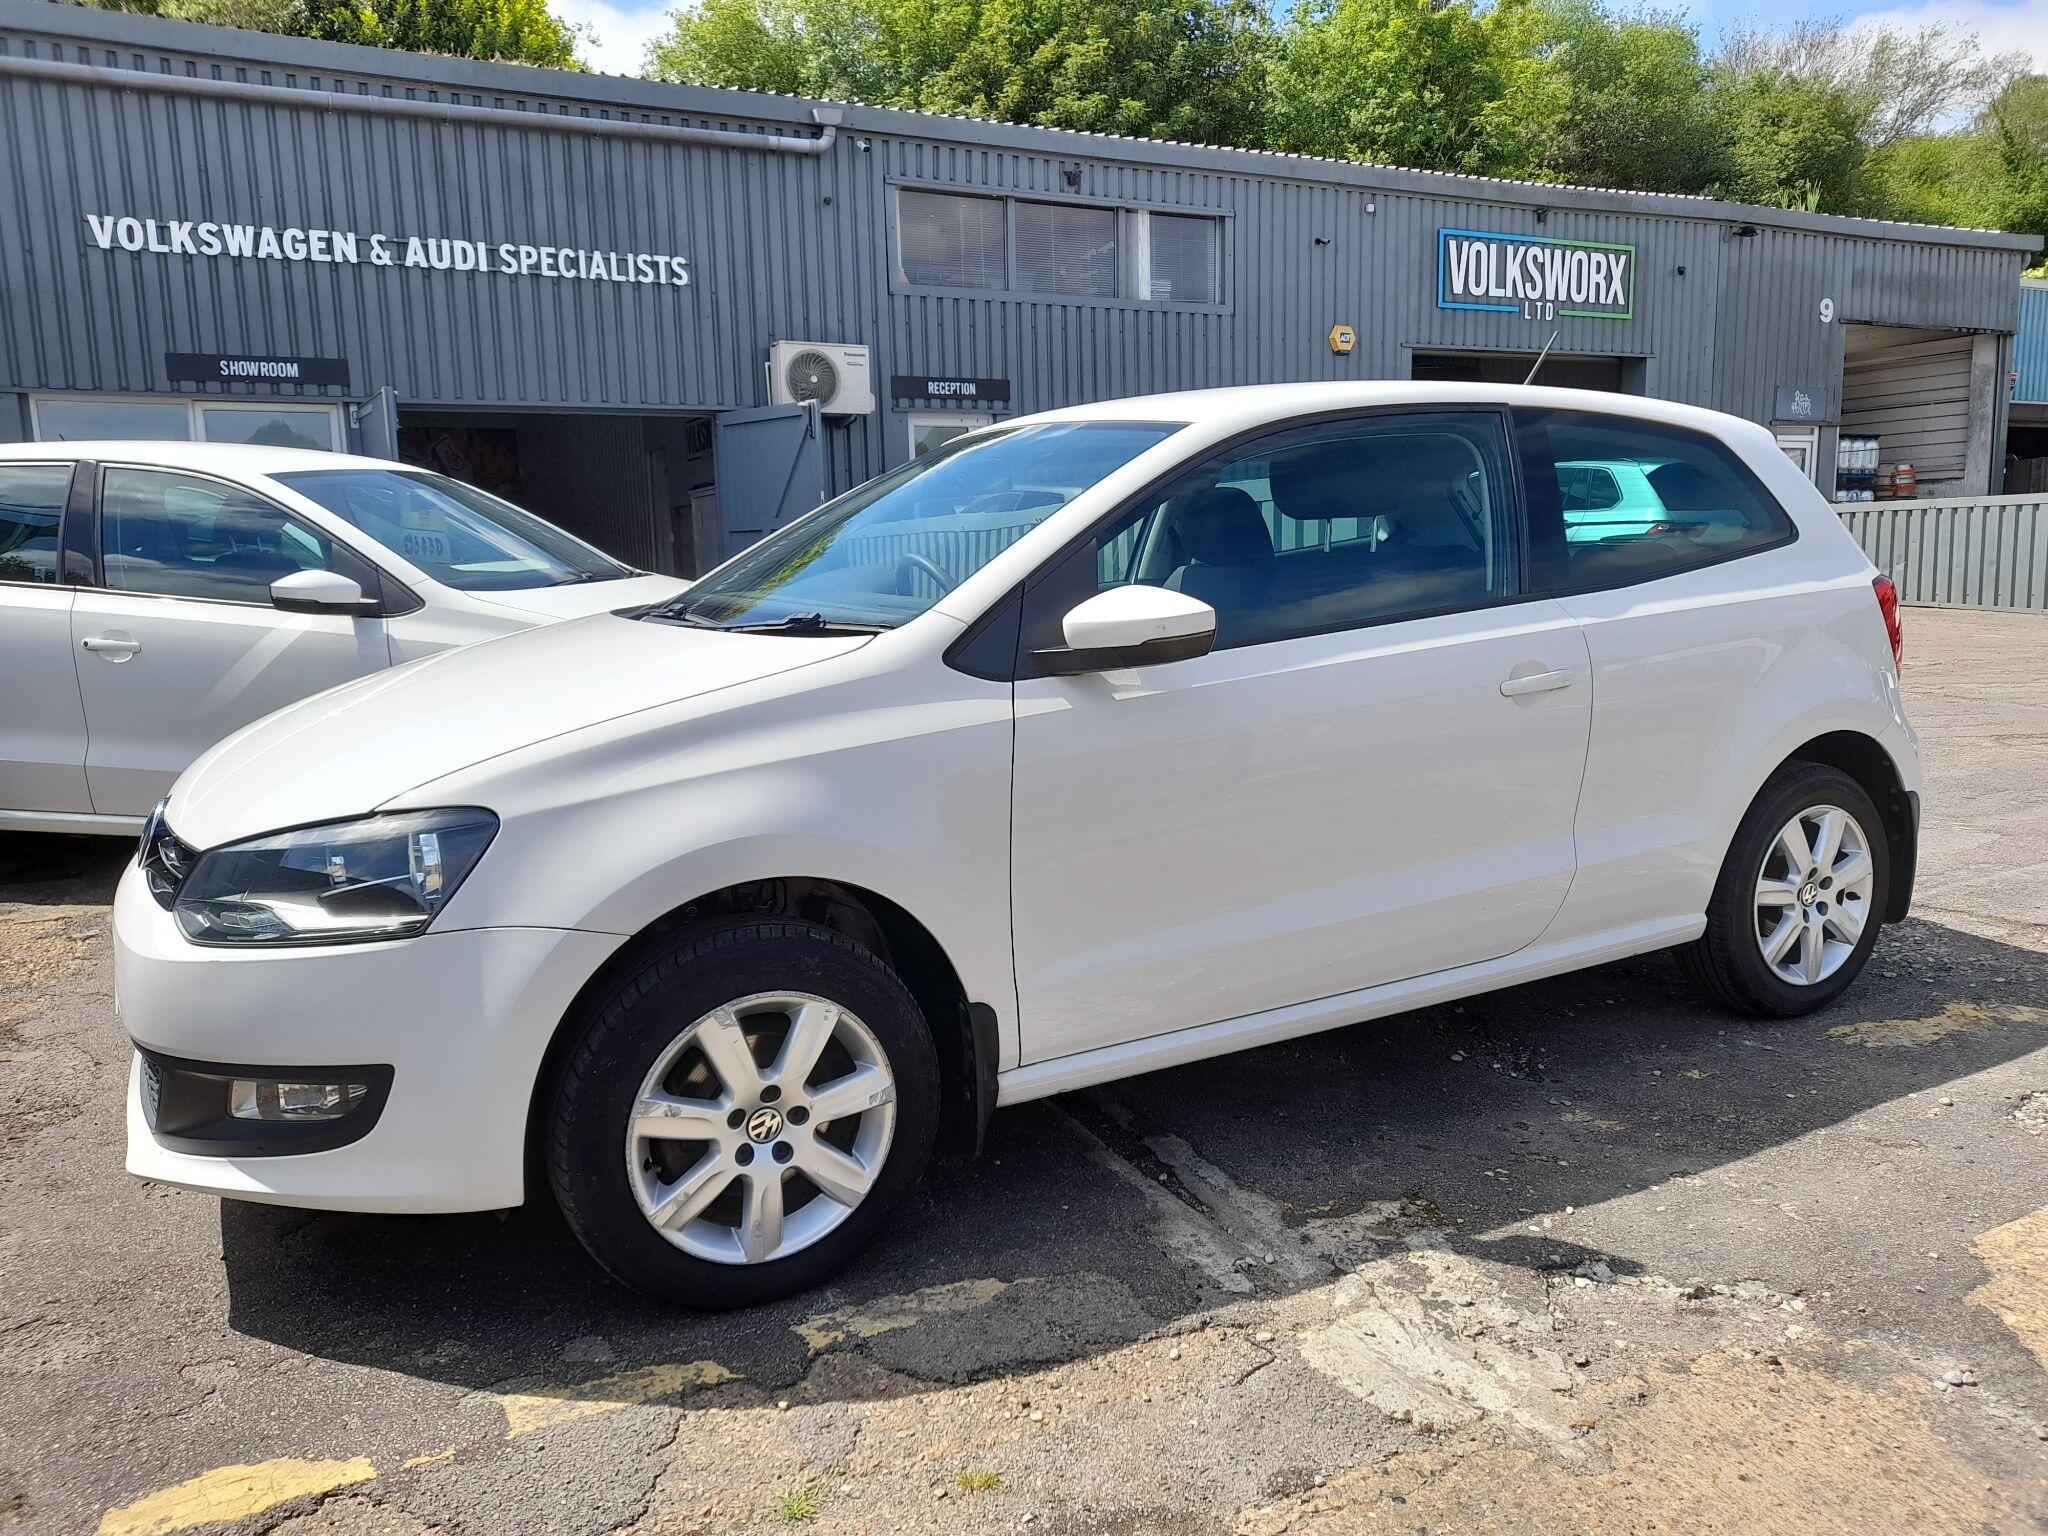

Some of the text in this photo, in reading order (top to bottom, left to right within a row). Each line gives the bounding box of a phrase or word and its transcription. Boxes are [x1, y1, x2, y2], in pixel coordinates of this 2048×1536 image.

[87, 214, 689, 286] VOLKSWAGEN & AUDI SPECIALISTS
[1449, 239, 1627, 306] VOLKSWORX
[1524, 301, 1554, 321] LTD
[1819, 297, 1834, 324] 9
[1340, 333, 1351, 342] ADT
[219, 359, 299, 378] SHOWROOM
[928, 381, 976, 396] RECEPTION
